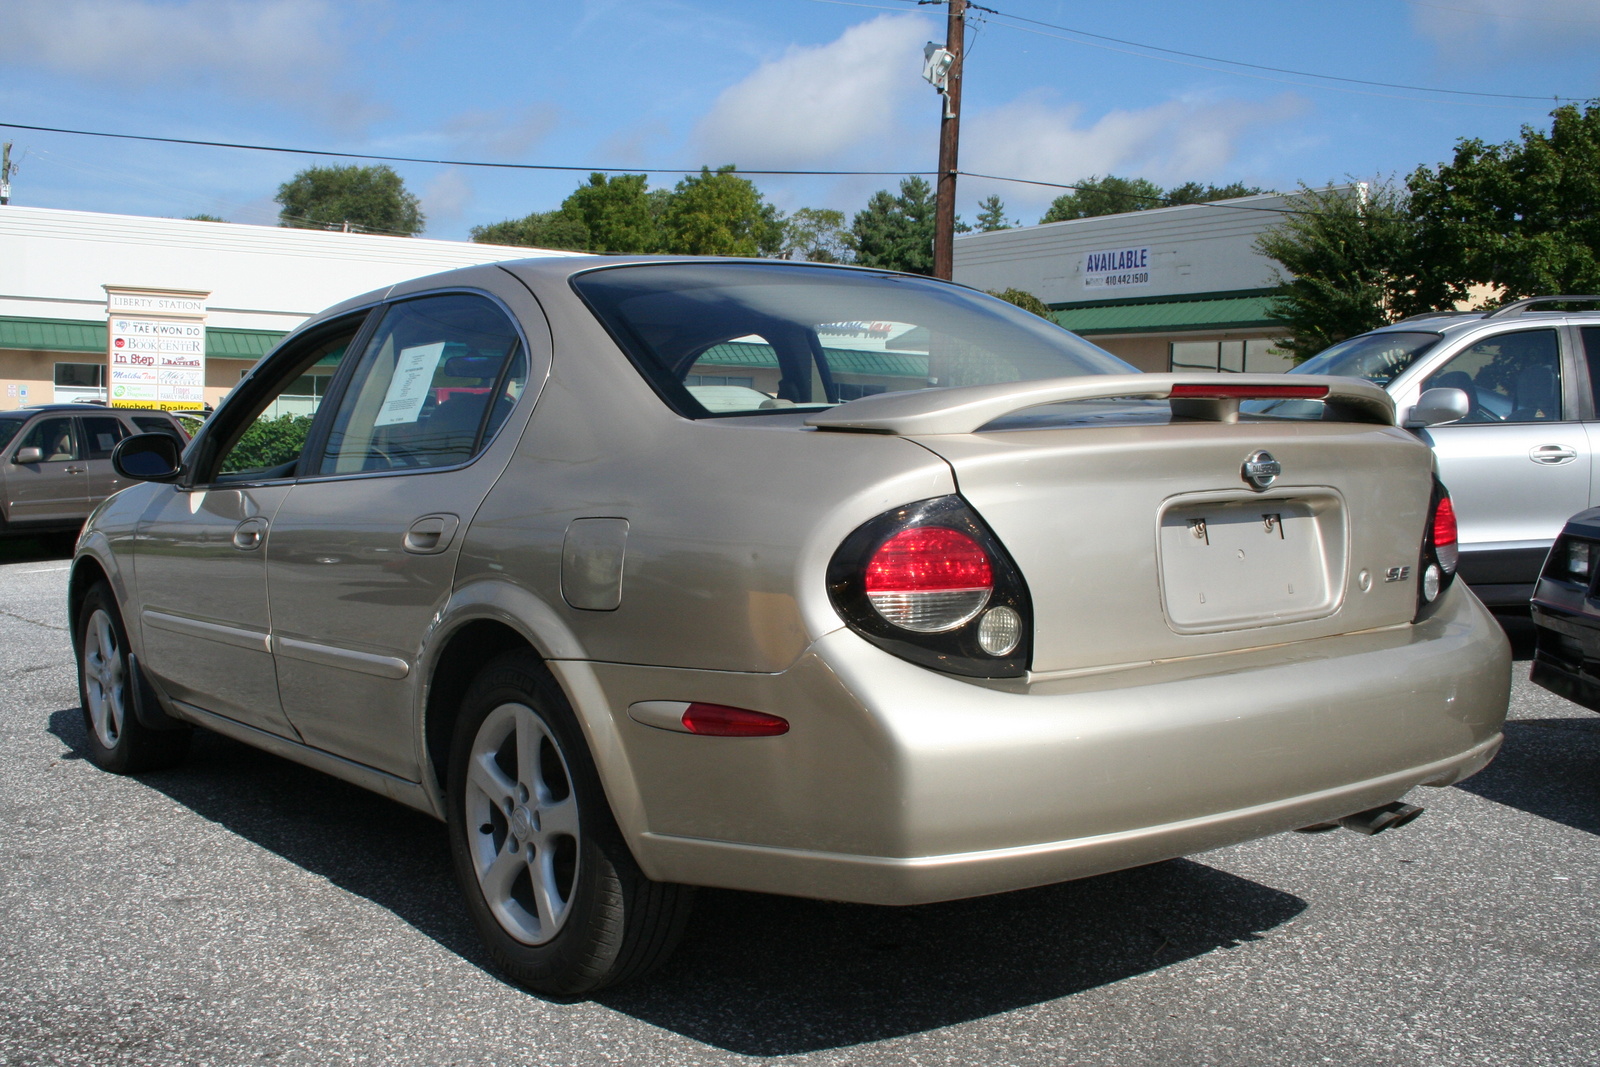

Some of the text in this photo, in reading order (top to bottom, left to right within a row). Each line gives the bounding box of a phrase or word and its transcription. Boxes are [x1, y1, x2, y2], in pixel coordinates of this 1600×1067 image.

[1086, 248, 1147, 272] AVAILABLE
[114, 297, 201, 310] LIBERTY STATION
[133, 325, 150, 333] TAE
[186, 328, 200, 336] DO
[114, 353, 155, 366] In Step
[113, 371, 141, 380] Malibu
[142, 372, 156, 380] Tan
[1385, 566, 1410, 582] SE
